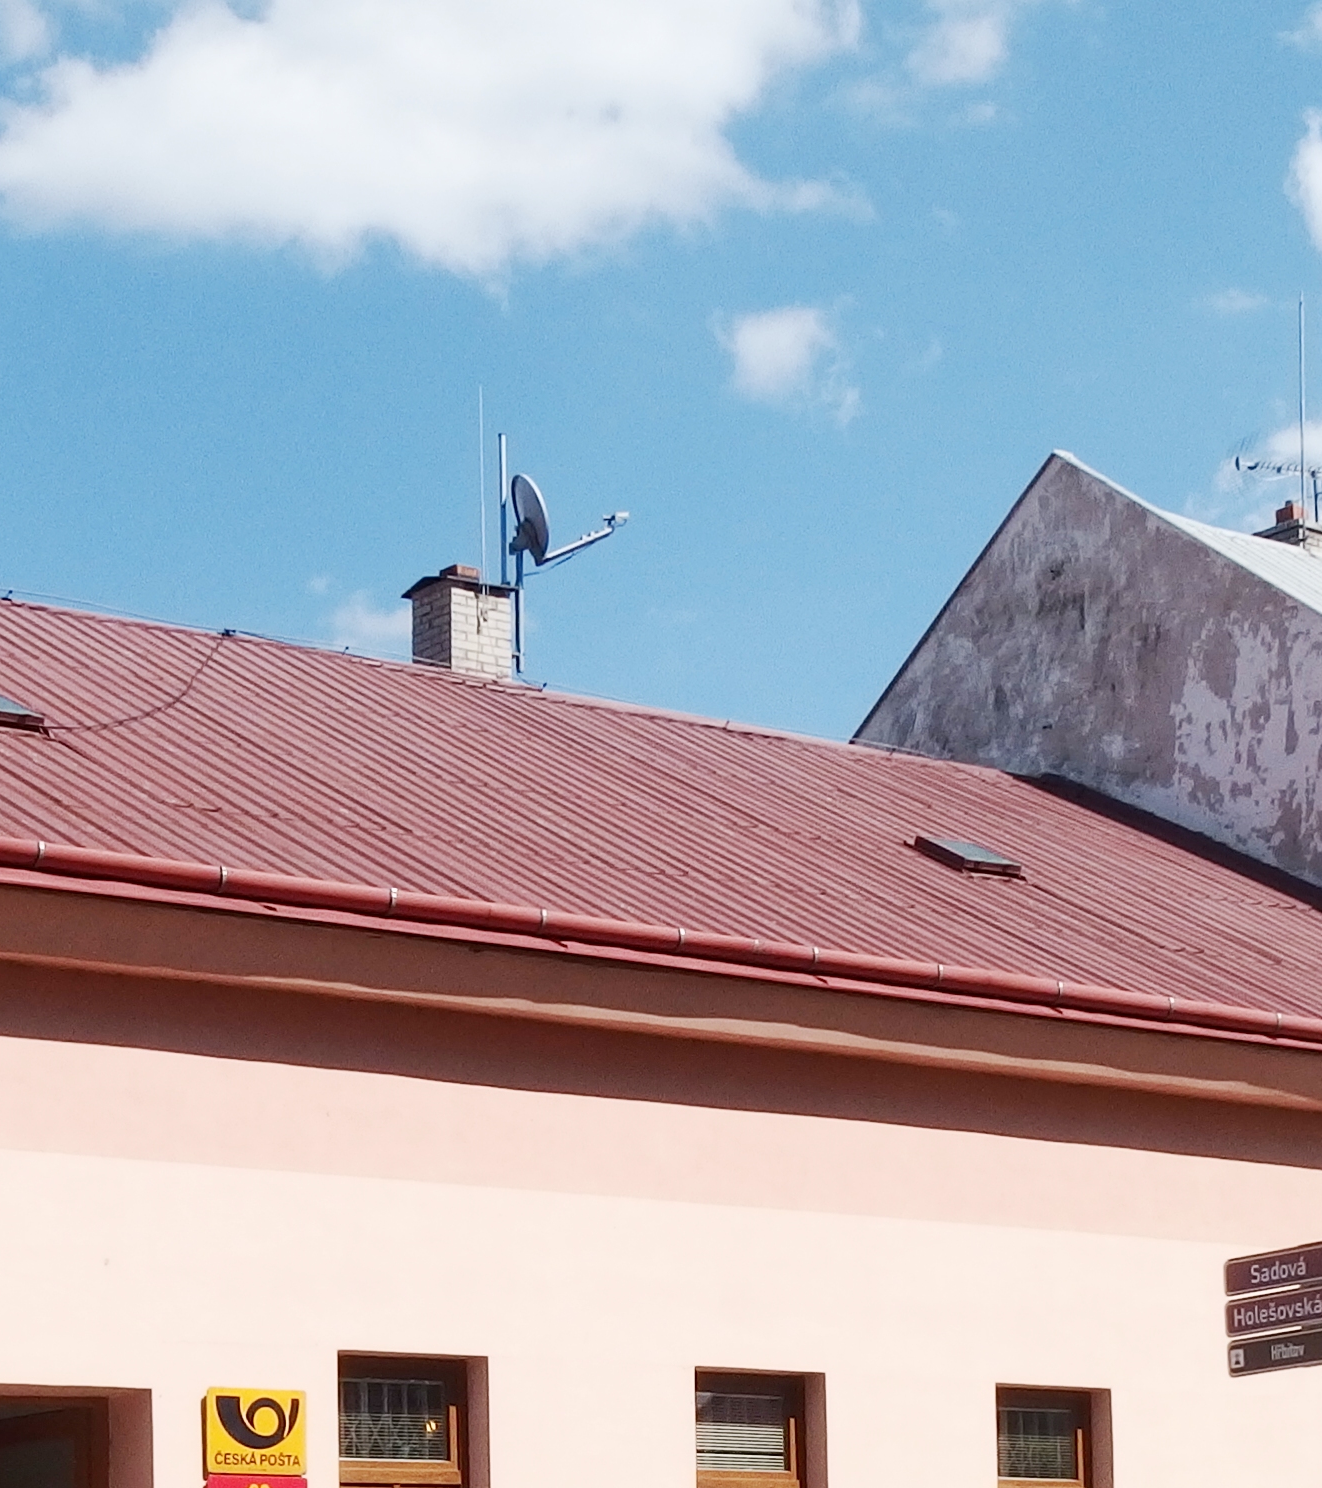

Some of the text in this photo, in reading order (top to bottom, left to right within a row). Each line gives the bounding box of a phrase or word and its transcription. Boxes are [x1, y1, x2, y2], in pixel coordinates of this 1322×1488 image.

[1250, 1256, 1306, 1284] Sadová
[1233, 1293, 1322, 1328] Holešovská
[214, 1450, 301, 1467] ČESKÁ POŠTA
